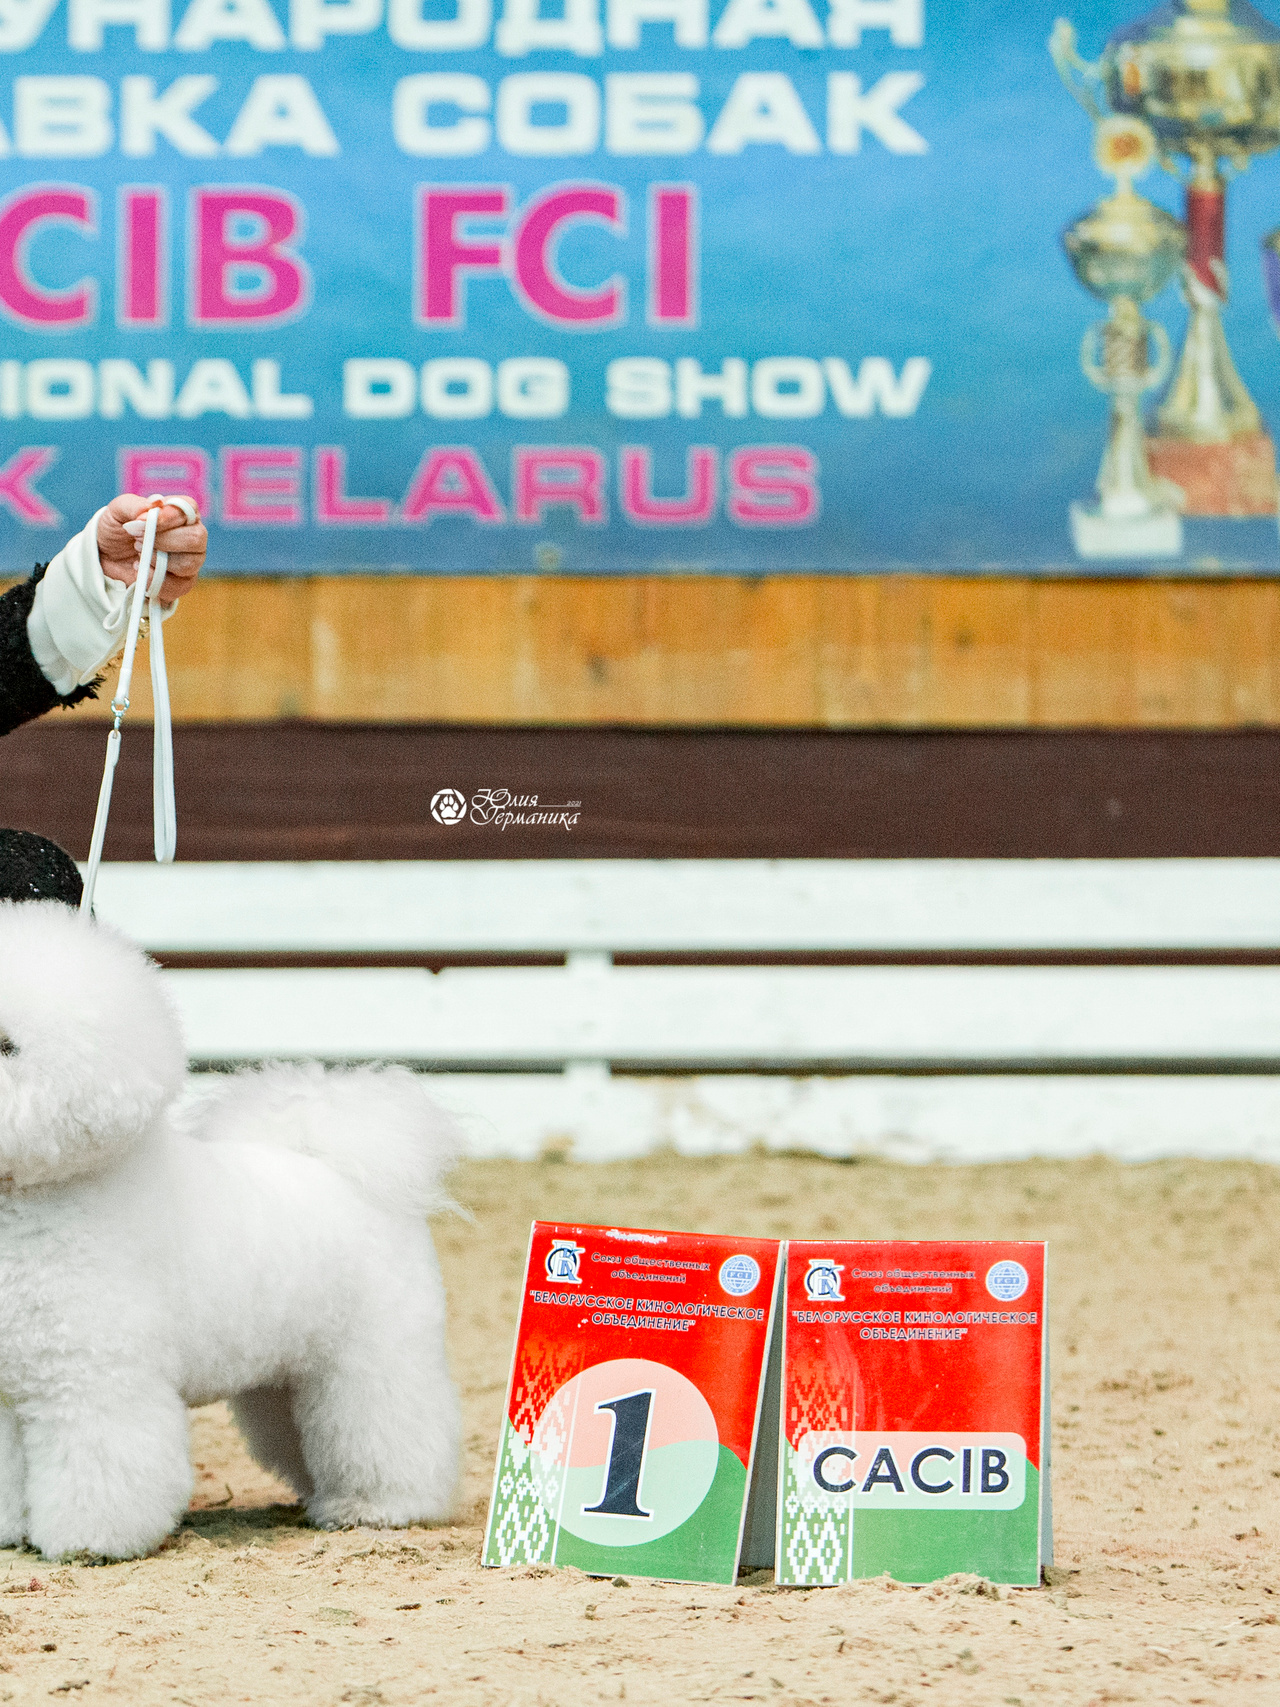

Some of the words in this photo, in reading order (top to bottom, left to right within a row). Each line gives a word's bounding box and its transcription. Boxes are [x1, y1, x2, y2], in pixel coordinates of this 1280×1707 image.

[392, 72, 929, 156] СОБАК
[414, 181, 700, 331] FCI
[342, 357, 570, 419] DOG
[605, 357, 931, 419] SHOW
[118, 444, 822, 528] BELARUS
[591, 1252, 622, 1264] Союз
[624, 1255, 711, 1271] общественных
[611, 1269, 687, 1284] объединений
[851, 1267, 883, 1279] Союз
[886, 1268, 976, 1279] общественных
[873, 1283, 953, 1294] объединений
[636, 1299, 765, 1321] КИНОЛОГИЧЕСКОЕ
[904, 1311, 1038, 1324] КИНОЛОГИЧЕСКОЕ
[581, 1389, 656, 1520] 1
[811, 1445, 1011, 1494] CACIB
